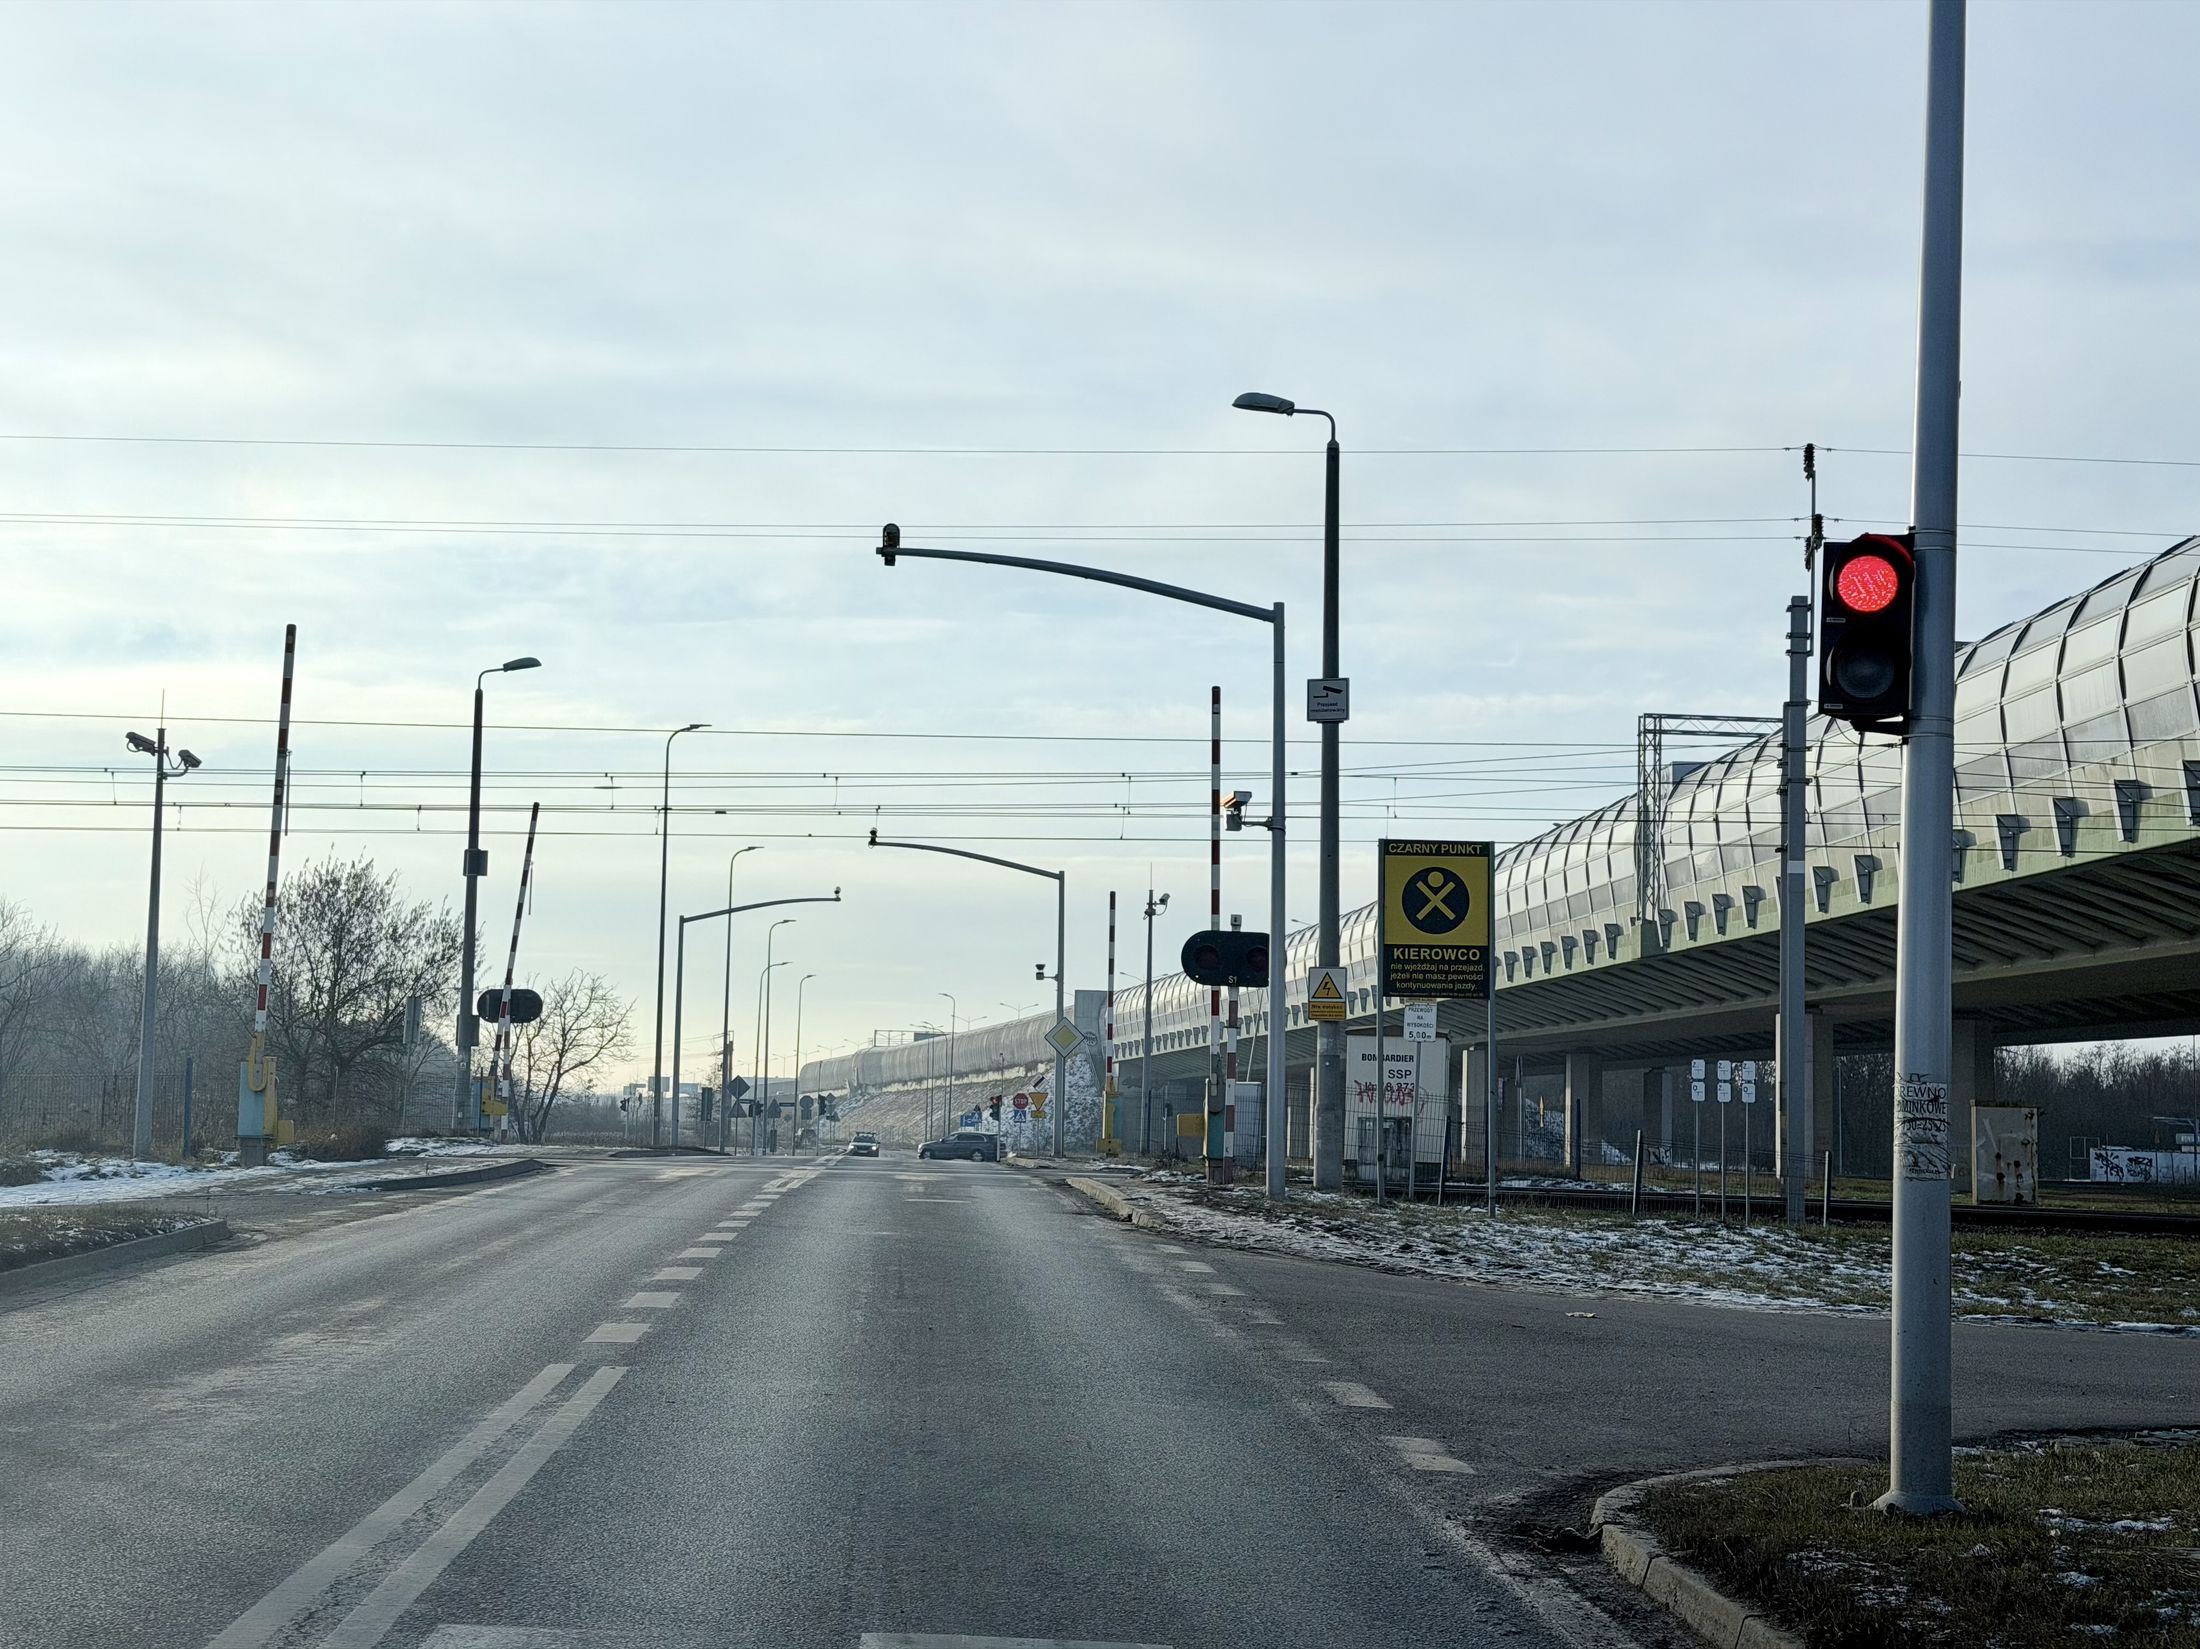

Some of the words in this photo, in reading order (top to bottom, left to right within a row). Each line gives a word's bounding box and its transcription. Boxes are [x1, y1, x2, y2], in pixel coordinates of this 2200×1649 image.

[1388, 843, 1438, 854] CZARNY
[1440, 844, 1483, 855] PUNKT
[1393, 947, 1480, 961] KIEROWCO
[1404, 963, 1438, 972] wjeżdżaj
[1228, 975, 1237, 984] S1
[1390, 972, 1410, 980] jeżeli
[1411, 972, 1424, 980] nie
[1447, 973, 1484, 982] pewności
[1396, 981, 1453, 990] kontynuowania
[1388, 1069, 1412, 1079] SSP
